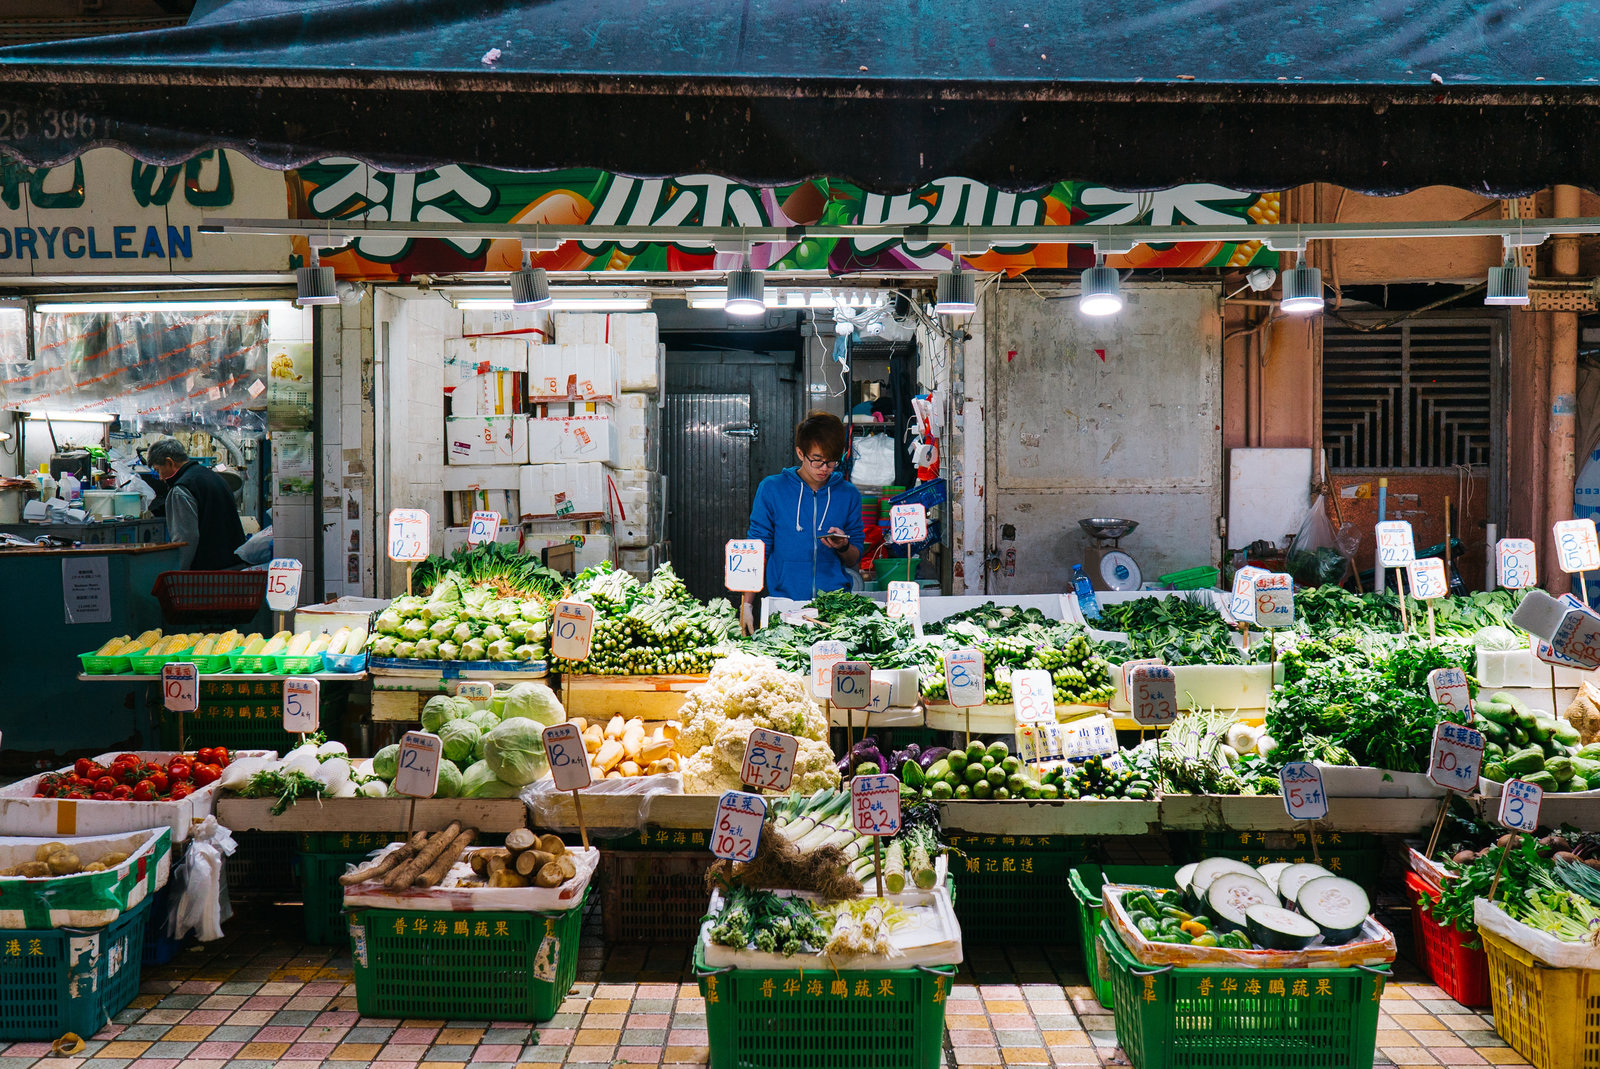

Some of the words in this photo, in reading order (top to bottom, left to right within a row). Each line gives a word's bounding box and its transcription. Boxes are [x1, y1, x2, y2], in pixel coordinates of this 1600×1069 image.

[472, 521, 485, 534] 10
[894, 528, 912, 541] 22
[392, 540, 408, 558] 12
[1562, 534, 1578, 552] 8
[730, 554, 746, 572] 12
[1382, 548, 1396, 562] 22
[1504, 555, 1519, 568] 10
[1564, 551, 1582, 568] 15
[268, 575, 287, 594] 15
[1416, 571, 1430, 584] 5
[1504, 569, 1520, 588] 18
[1236, 579, 1252, 596] 12
[1233, 598, 1252, 616] 22
[1259, 594, 1276, 614] 8
[556, 620, 576, 640] 10
[836, 676, 856, 694] 10
[951, 664, 970, 688] 8
[165, 680, 182, 698] 10
[1020, 677, 1032, 696] 5
[1140, 684, 1150, 700] 5
[287, 694, 302, 716] 5
[1020, 696, 1038, 720] 8
[1041, 701, 1051, 715] 2
[1138, 702, 1156, 718] 12
[1158, 701, 1170, 720] 3
[1444, 725, 1481, 748] 紅菜頭
[400, 749, 420, 771] 12
[548, 744, 570, 766] 18
[749, 748, 767, 766] 8
[772, 754, 782, 770] 1
[1436, 750, 1458, 772] 10
[746, 762, 764, 783] 14
[767, 770, 782, 788] 2
[1286, 764, 1316, 781] 冬瓜
[856, 798, 871, 810] 10
[1290, 788, 1304, 808] 5
[1305, 789, 1320, 804] 元斤
[858, 812, 874, 828] 18
[879, 810, 890, 828] 2
[1506, 798, 1524, 826] 3
[720, 813, 730, 831] 6
[716, 834, 734, 854] 10
[736, 838, 752, 858] 2
[966, 856, 1034, 874] 顺记配送
[392, 917, 510, 937] 普华海鹏蔬果
[5, 938, 44, 956] 港菜
[759, 978, 896, 998] 普华海鹏蔬果
[1197, 976, 1334, 998] 普华海鹏蔬果
